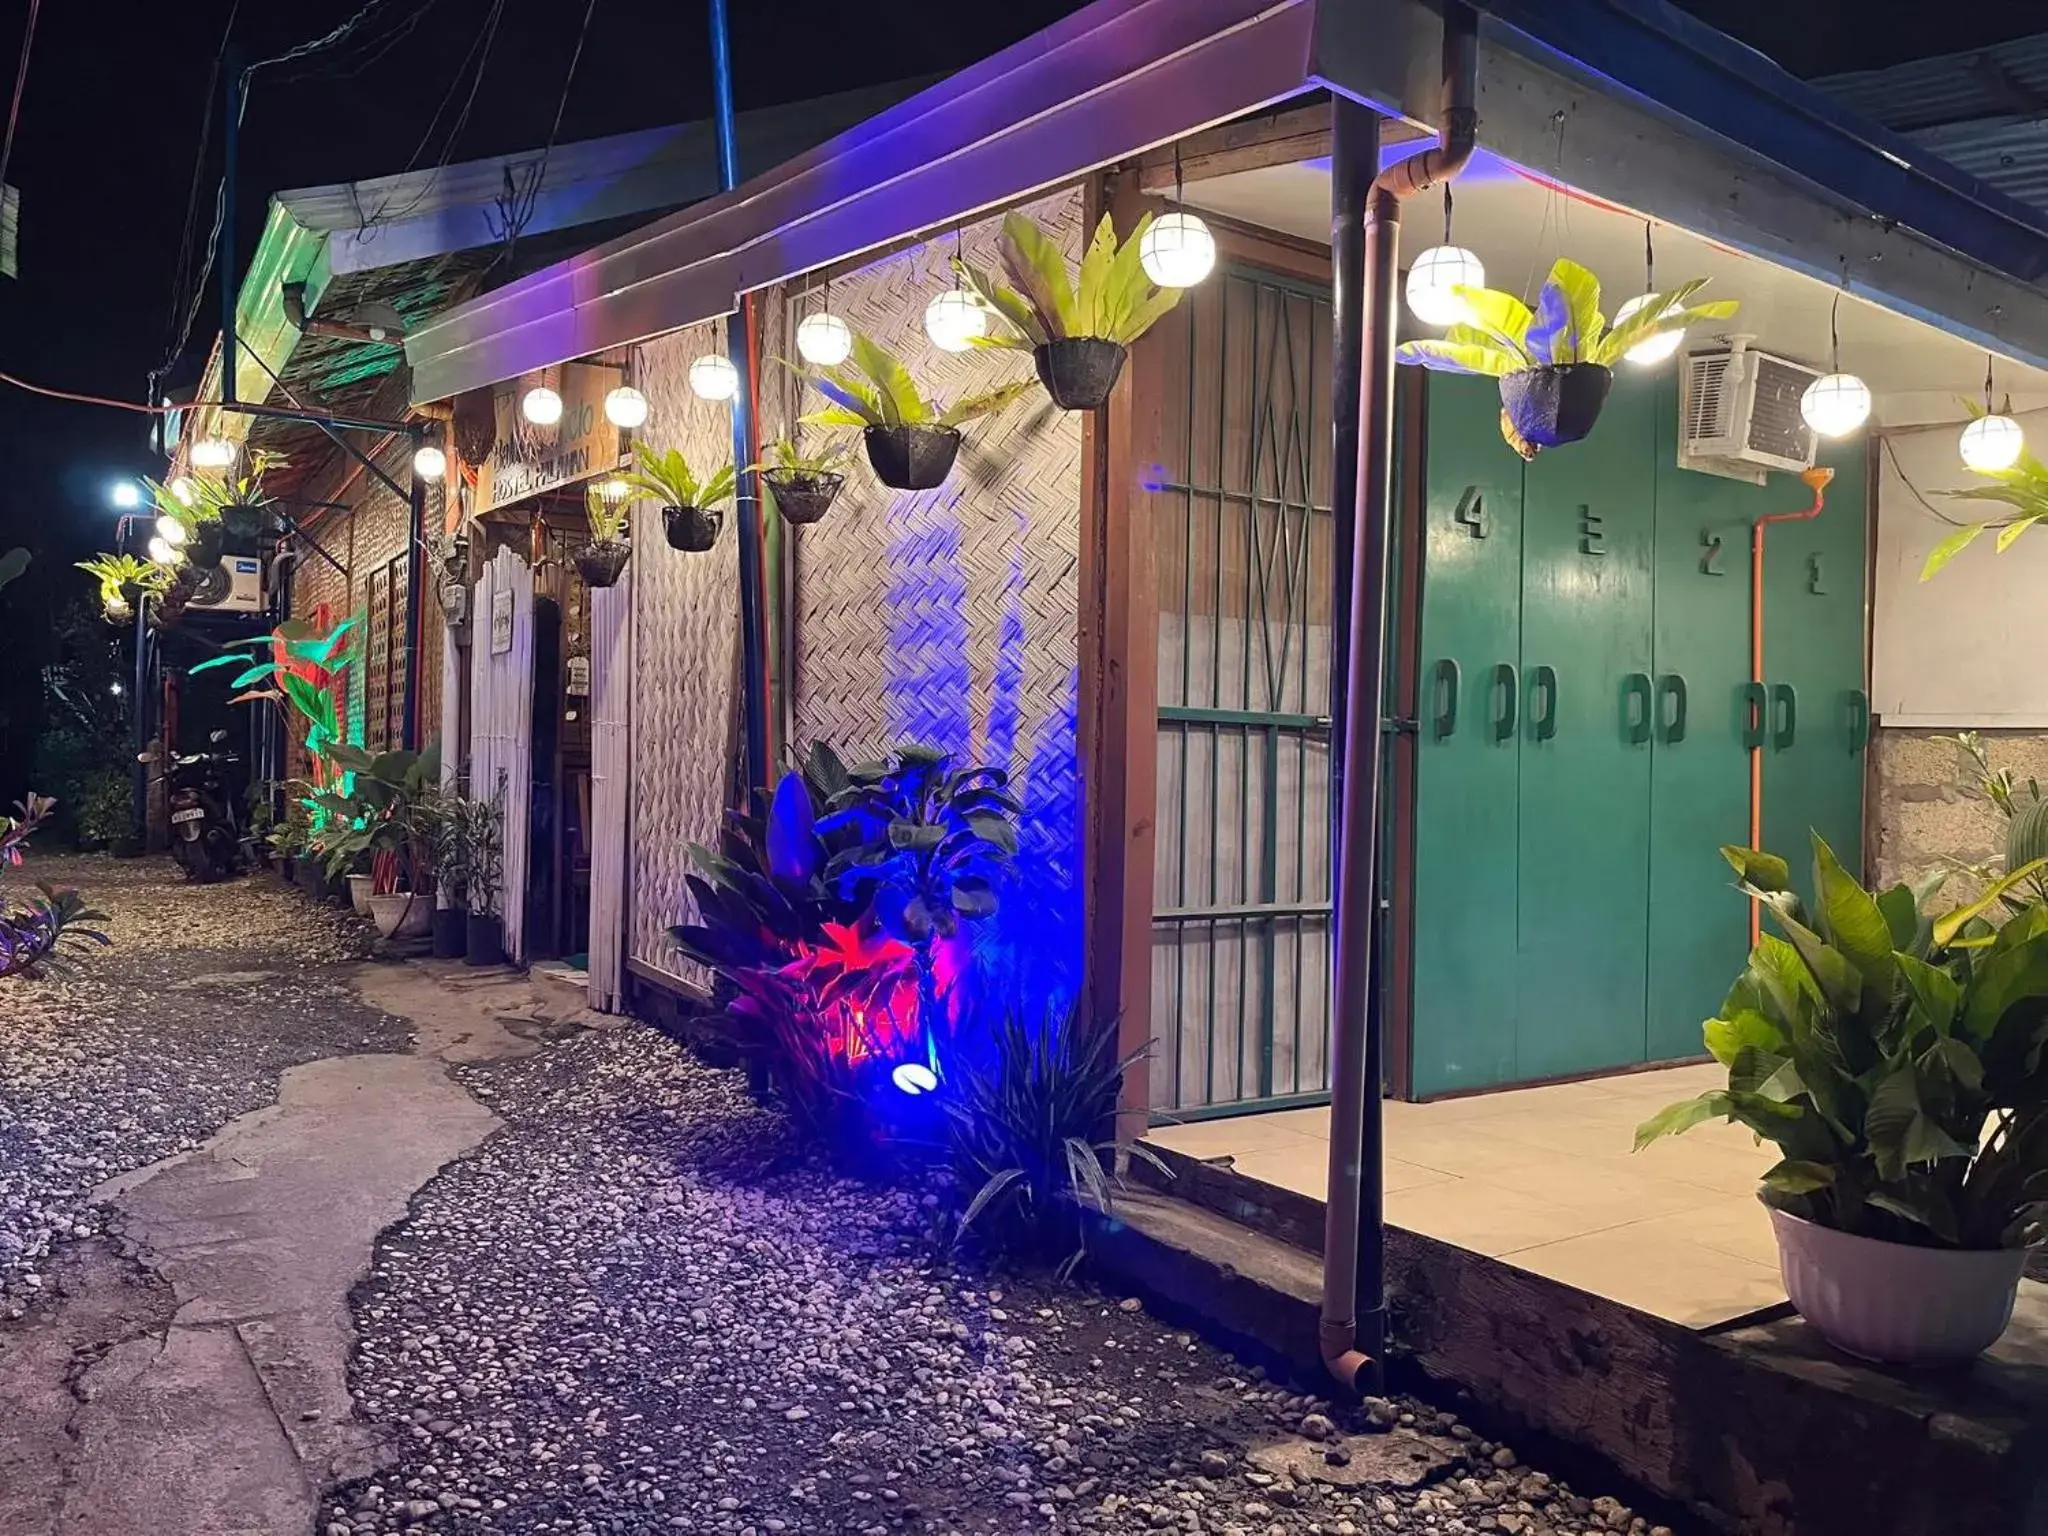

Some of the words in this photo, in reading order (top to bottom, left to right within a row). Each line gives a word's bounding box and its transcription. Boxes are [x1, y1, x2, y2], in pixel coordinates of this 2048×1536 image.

[493, 467, 533, 503] HOSTEL
[1455, 485, 1489, 539] 4
[1697, 524, 1726, 578] 2
